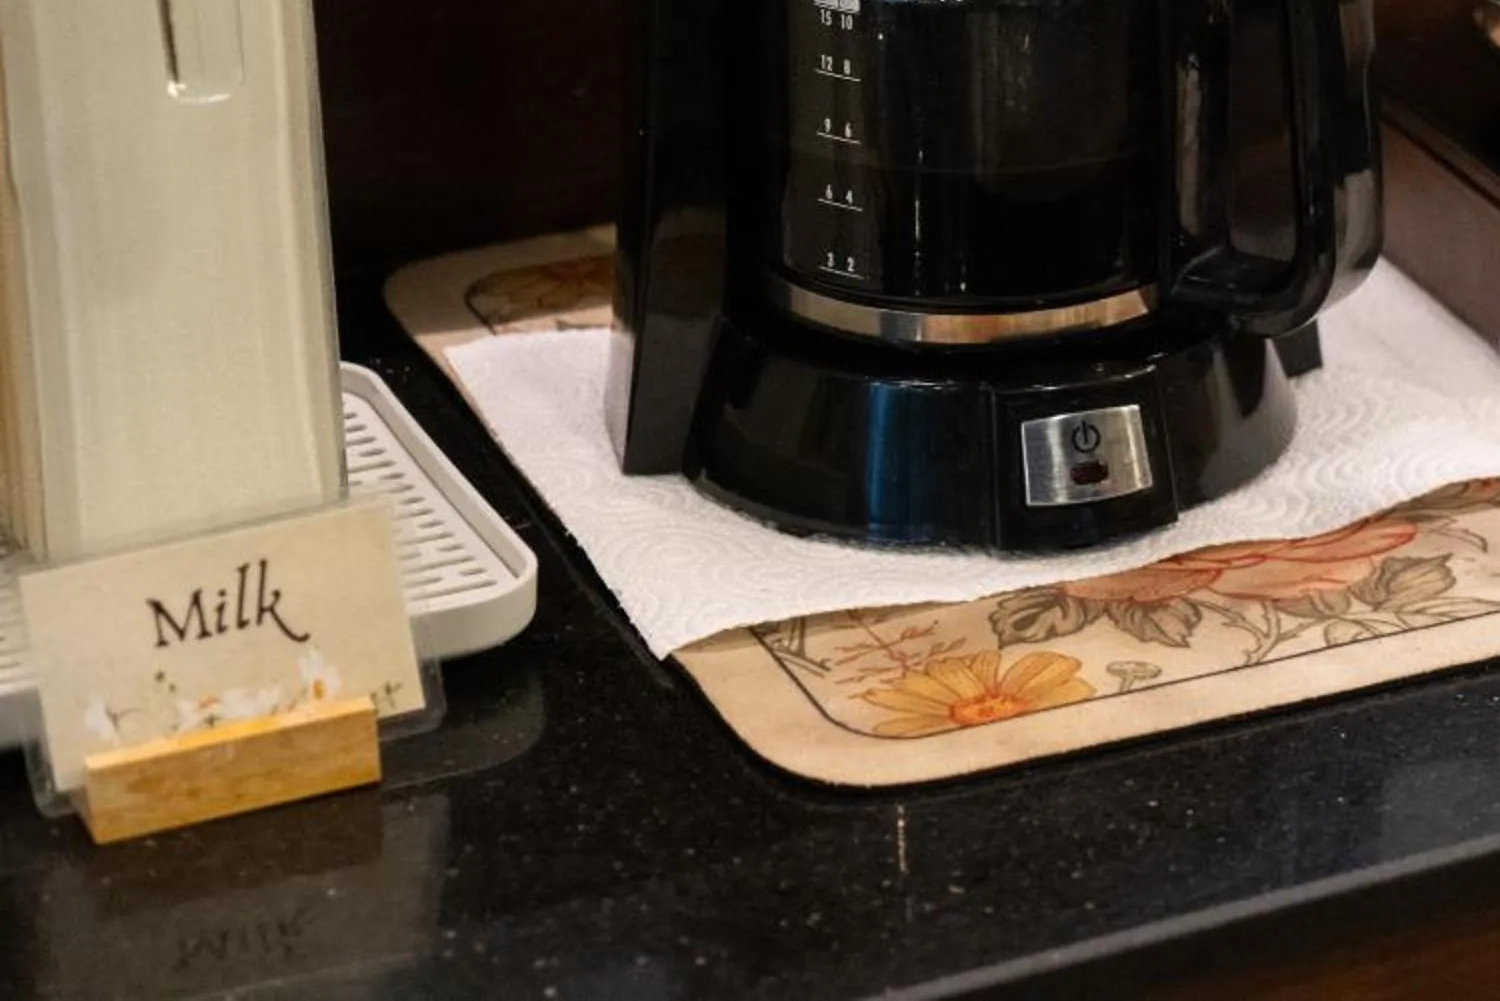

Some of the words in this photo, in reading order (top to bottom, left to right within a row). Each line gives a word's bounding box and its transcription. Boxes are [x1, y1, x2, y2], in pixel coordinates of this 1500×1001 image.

[820, 8, 832, 26] 15
[841, 14, 853, 30] 10
[821, 54, 833, 71] 12
[146, 558, 311, 648] Milk
